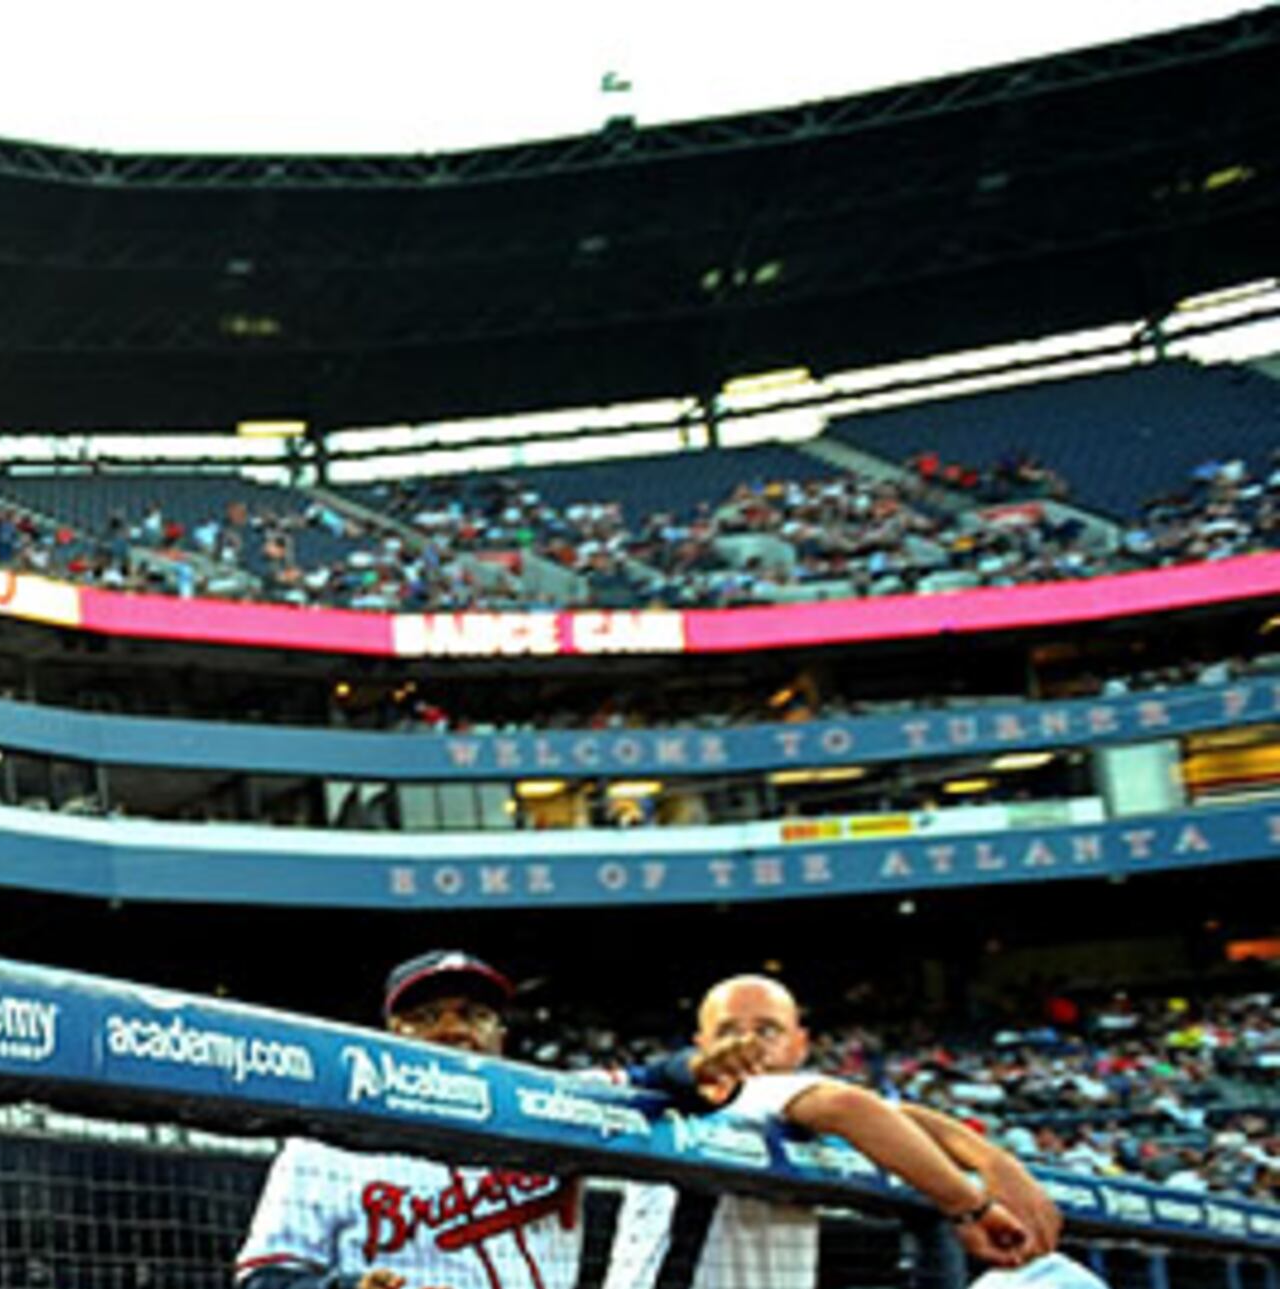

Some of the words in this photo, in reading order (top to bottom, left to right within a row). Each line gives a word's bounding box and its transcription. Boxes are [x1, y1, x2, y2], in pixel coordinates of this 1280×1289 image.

[447, 735, 728, 767] WELCOME
[774, 726, 851, 759] TO
[390, 864, 554, 894] HOME
[598, 861, 665, 891] OF
[709, 854, 832, 888] THE
[880, 824, 1210, 879] ATLANTA
[106, 1014, 315, 1082] academy.com
